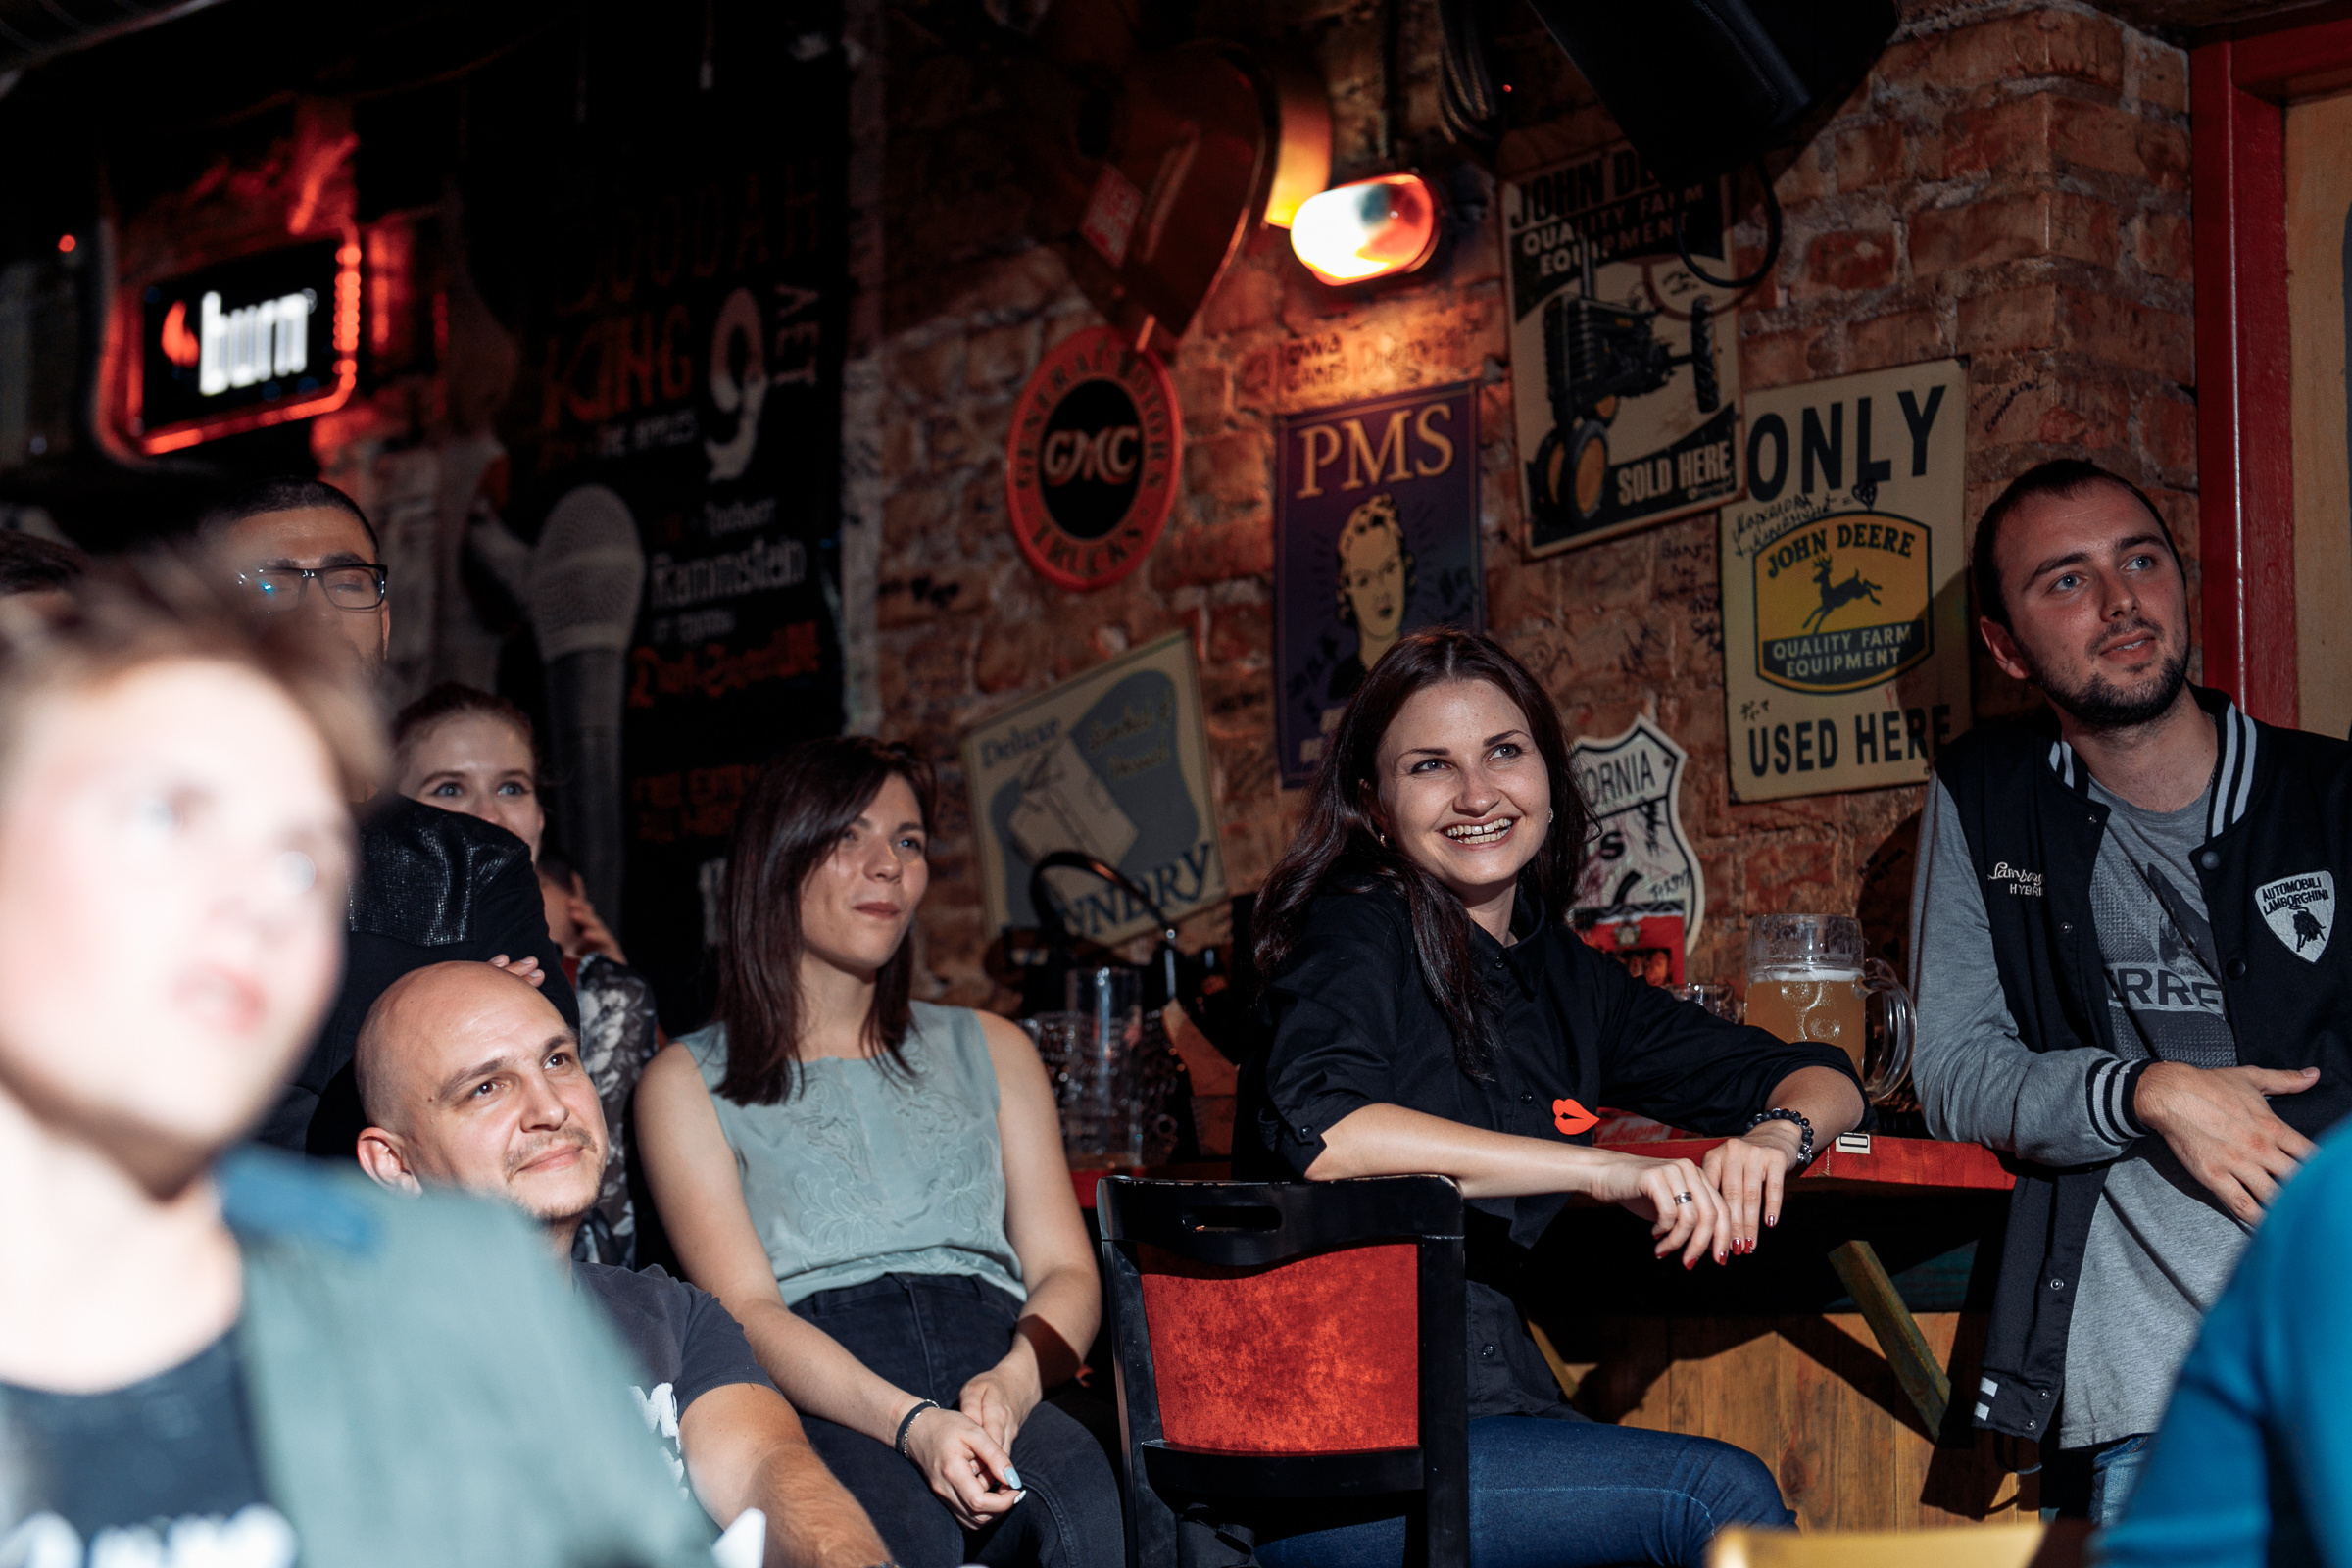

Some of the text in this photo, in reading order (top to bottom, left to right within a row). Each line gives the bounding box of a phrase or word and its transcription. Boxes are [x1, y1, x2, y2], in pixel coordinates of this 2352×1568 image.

[1512, 159, 1603, 229] JOHN
[199, 289, 310, 397] burn
[1043, 424, 1143, 488] GMC
[1295, 402, 1455, 501] PMS
[1616, 456, 1673, 507] SOLD
[1677, 439, 1731, 490] HERE
[1746, 385, 1947, 503] ONLY
[1767, 529, 1828, 579] JOHN
[1837, 523, 1916, 558] DEERE
[1773, 623, 1913, 662] QUALITY FARM
[1787, 647, 1901, 679] EQUIPMENT
[1748, 703, 1951, 777] USED HERE
[1582, 750, 1657, 808] ORNIA
[1986, 861, 2045, 887] Lamborg
[2262, 876, 2322, 903] AUTOMOBILI
[2263, 889, 2329, 916] LAMBORGHINI
